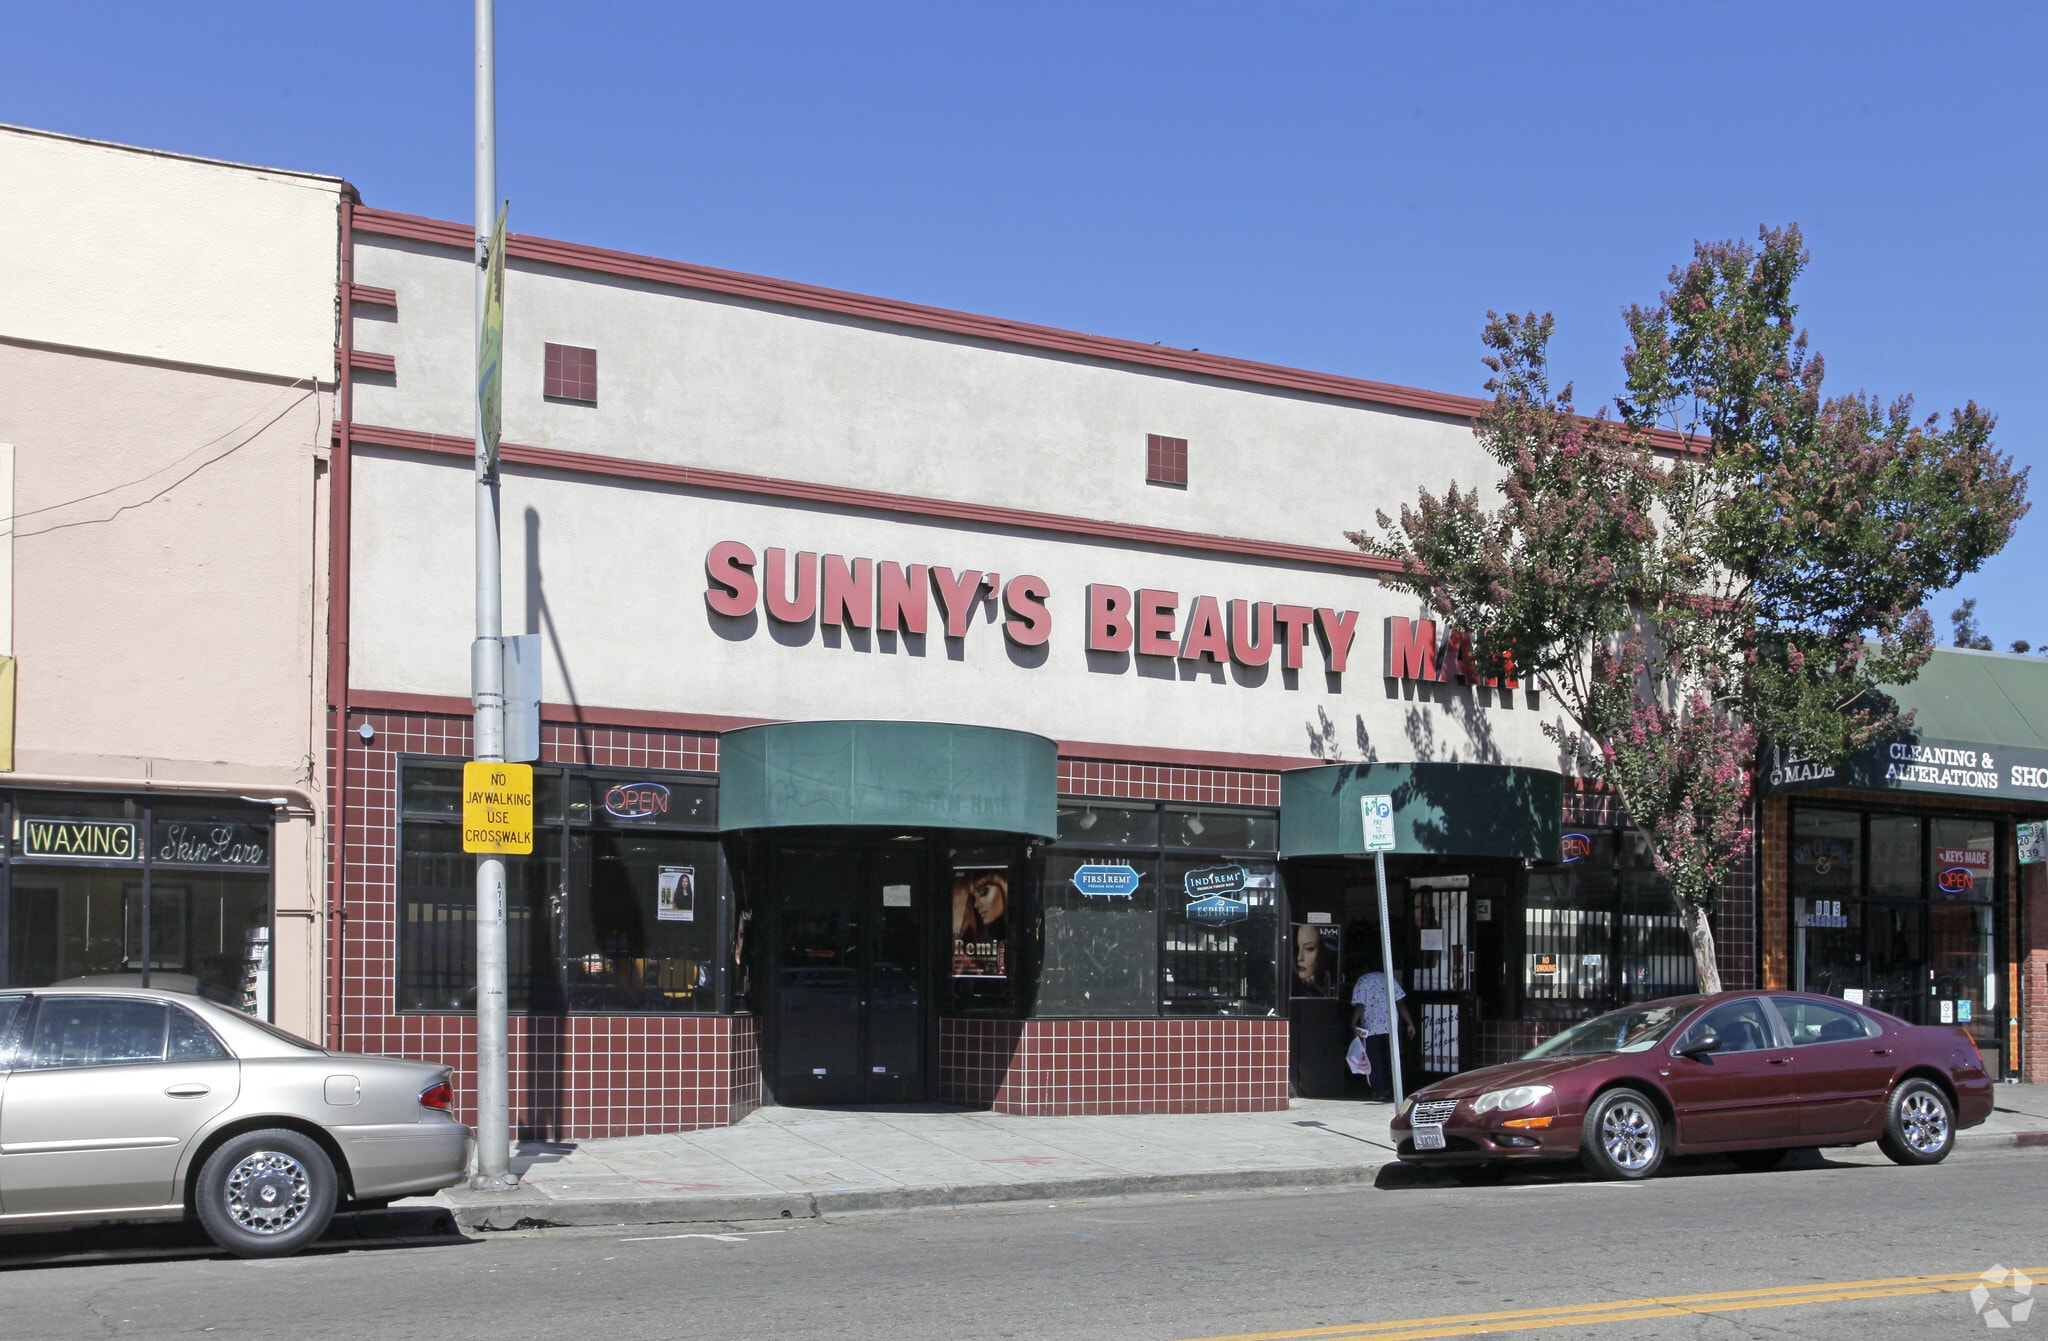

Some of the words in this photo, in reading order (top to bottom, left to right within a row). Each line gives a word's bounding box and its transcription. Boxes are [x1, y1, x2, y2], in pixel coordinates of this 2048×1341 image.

[704, 540, 1053, 646] SUNNY'S
[1085, 583, 1360, 673] BEAUTY
[1889, 743, 1977, 767] CLEANING
[1981, 752, 1994, 769] &
[491, 774, 506, 786] NO
[1784, 763, 1835, 784] MADE
[1885, 763, 1998, 789] ALTERATIONS
[466, 791, 531, 806] JAYWALKING
[605, 789, 668, 813] OPEN
[487, 811, 509, 824] USE
[30, 823, 129, 854] WAXING
[160, 824, 211, 861] Skin
[465, 829, 531, 844] CROSSWALK
[1562, 840, 1591, 856] PEN
[2019, 848, 2039, 858] 339
[1945, 850, 1964, 863] KEYS
[1964, 851, 1986, 864] MADE
[1938, 871, 1974, 890] OPEN
[1319, 928, 1338, 936] NYX
[954, 939, 998, 955] Remi
